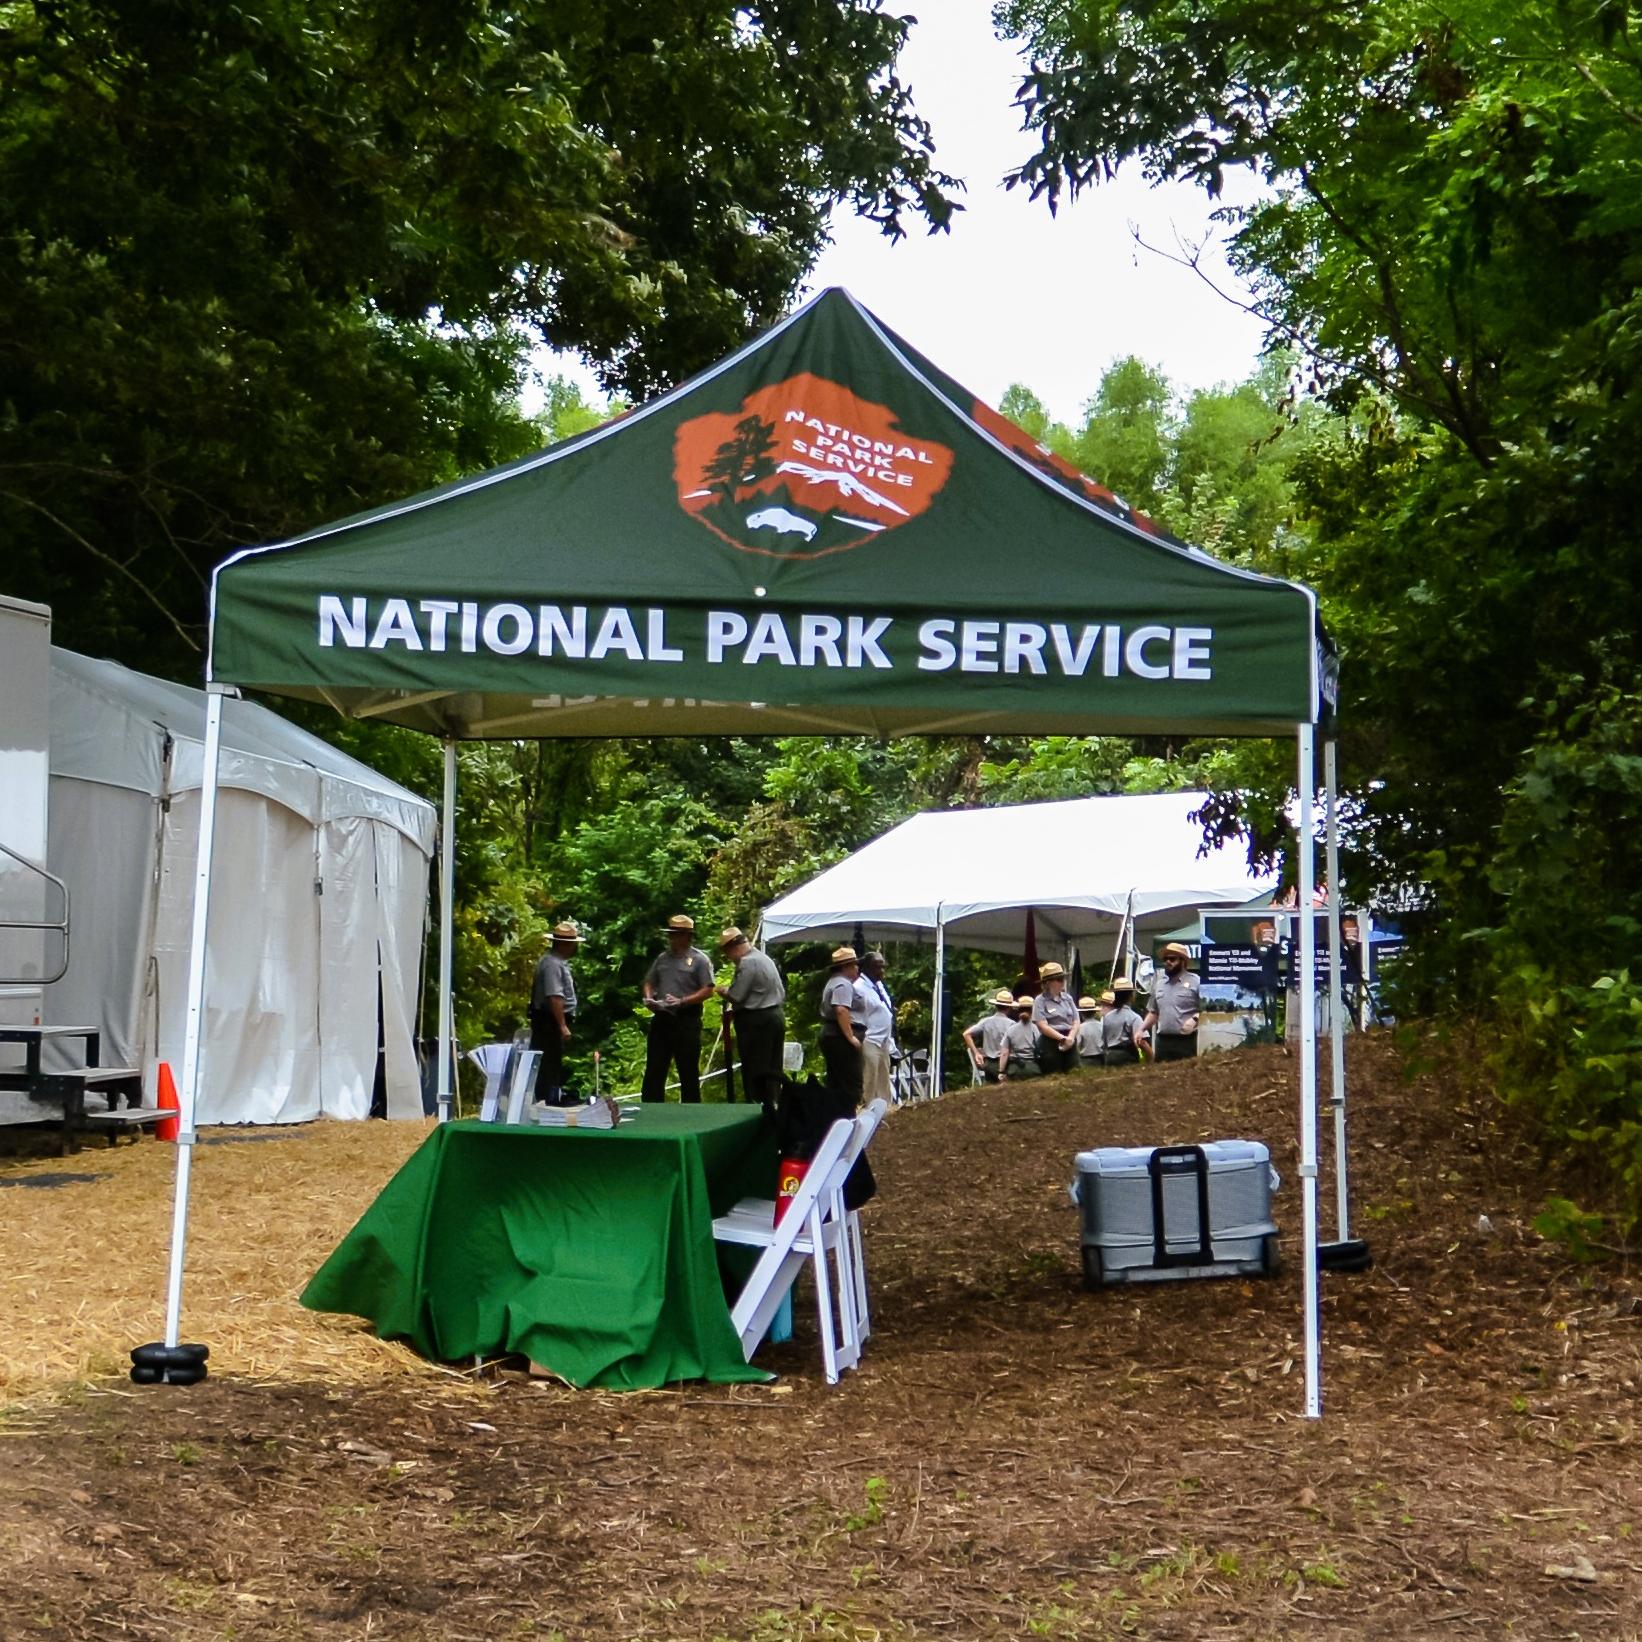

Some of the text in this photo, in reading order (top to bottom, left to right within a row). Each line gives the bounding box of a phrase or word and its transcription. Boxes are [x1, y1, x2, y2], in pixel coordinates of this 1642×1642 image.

[784, 409, 933, 464] NATIONAL
[816, 434, 893, 469] PARK
[792, 439, 914, 487] SERVICE
[318, 595, 1212, 681] NATIONAL PARK SERVICE
